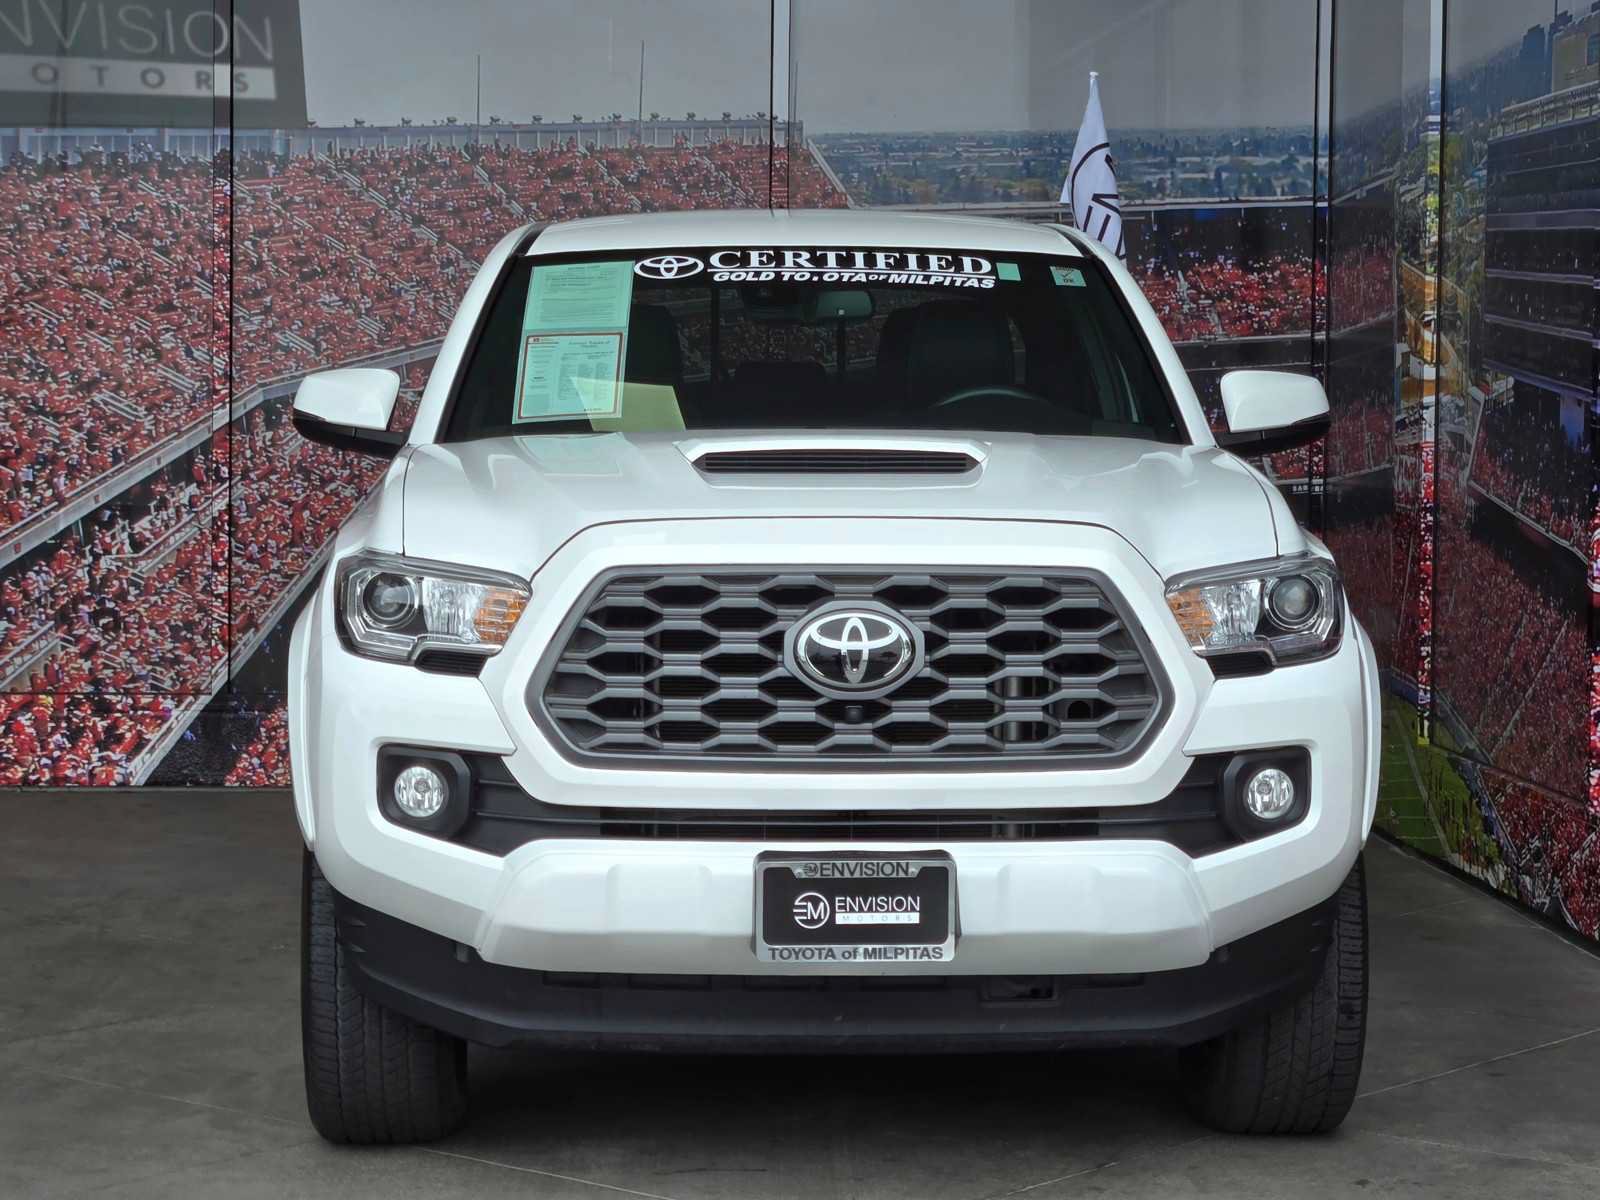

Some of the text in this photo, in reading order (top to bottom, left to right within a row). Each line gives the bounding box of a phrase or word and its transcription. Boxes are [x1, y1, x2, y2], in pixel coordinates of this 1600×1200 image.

[31, 61, 250, 94] OTORS
[709, 250, 992, 274] CERTIFIED
[713, 271, 776, 282] GOLD
[781, 271, 867, 283] TOOTA
[888, 273, 996, 289] MILPITAS
[820, 862, 910, 877] ENVISION
[835, 896, 920, 912] ENVISION
[842, 914, 913, 922] MOTORS
[770, 946, 944, 961] TOYOTA of MILPITAS
